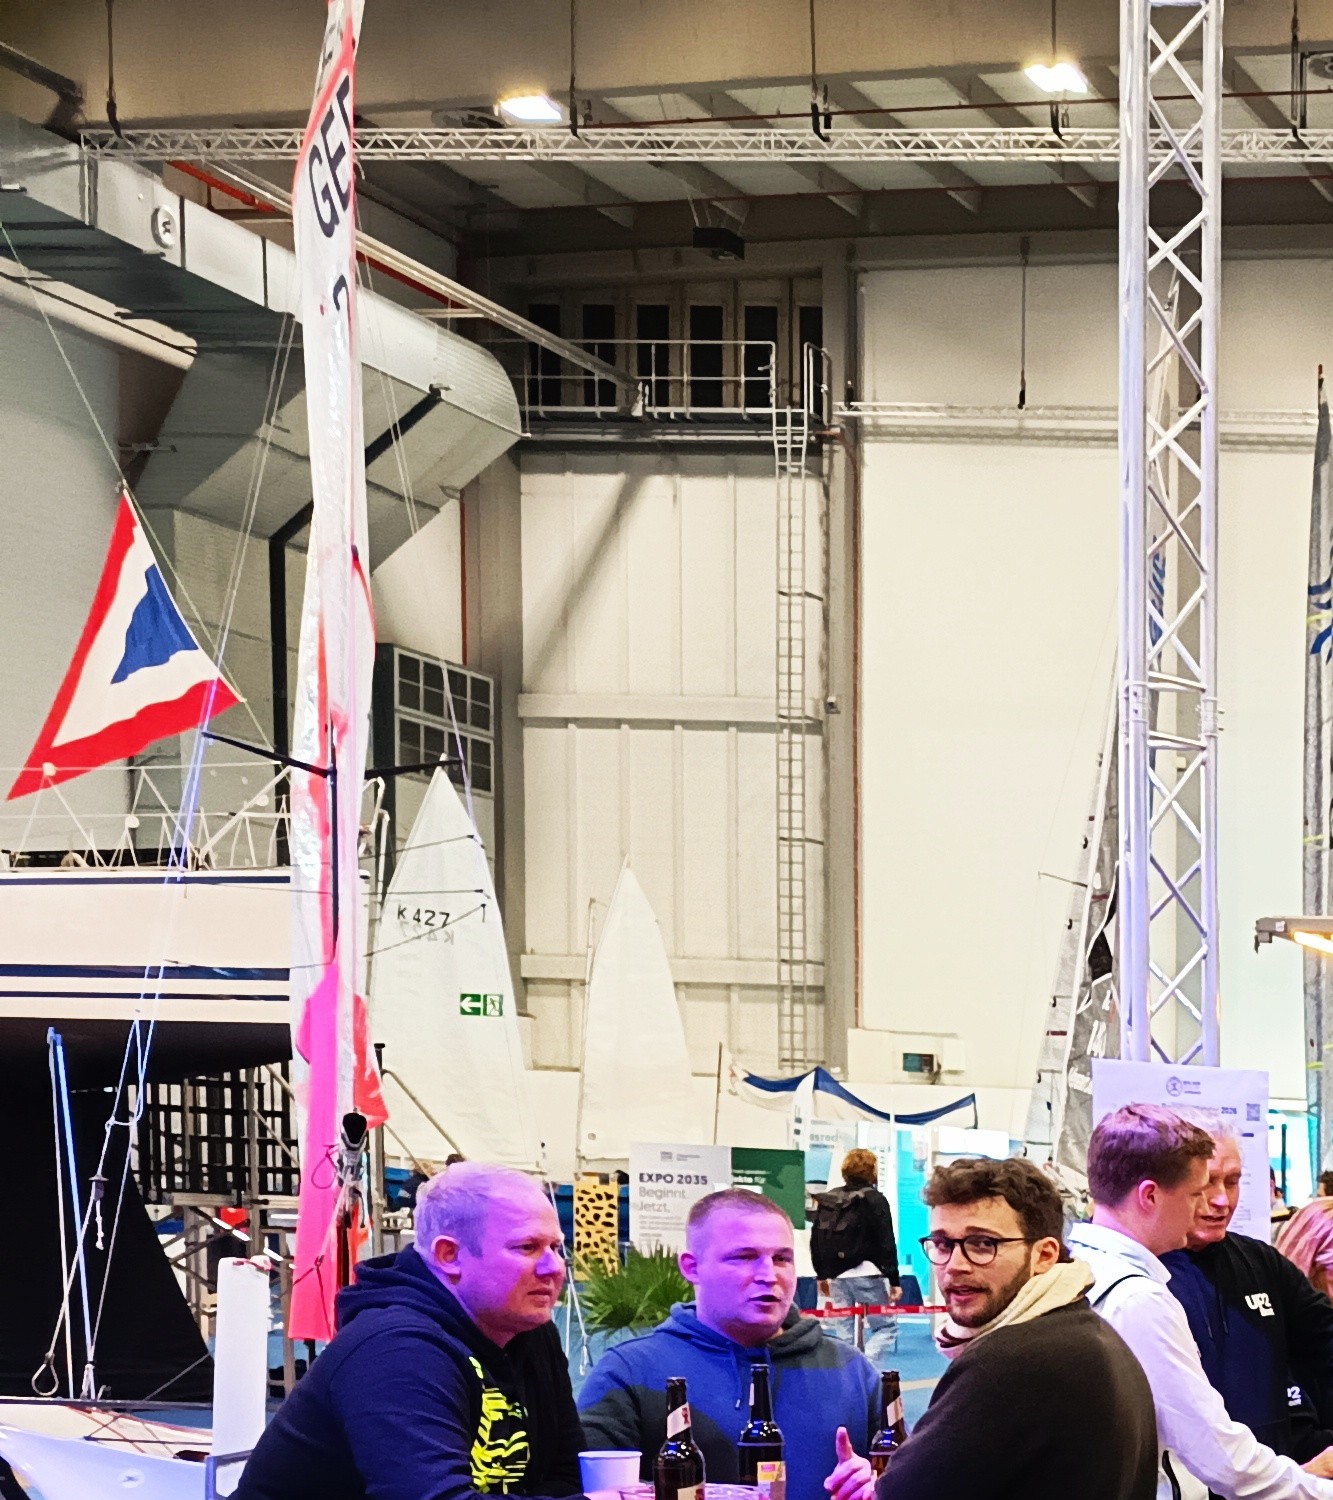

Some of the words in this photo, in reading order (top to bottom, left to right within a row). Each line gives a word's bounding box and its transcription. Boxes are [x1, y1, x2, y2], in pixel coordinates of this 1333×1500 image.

[397, 904, 407, 920] K
[412, 908, 450, 928] 427
[639, 1173, 674, 1184] EXPO
[677, 1174, 708, 1185] 2035
